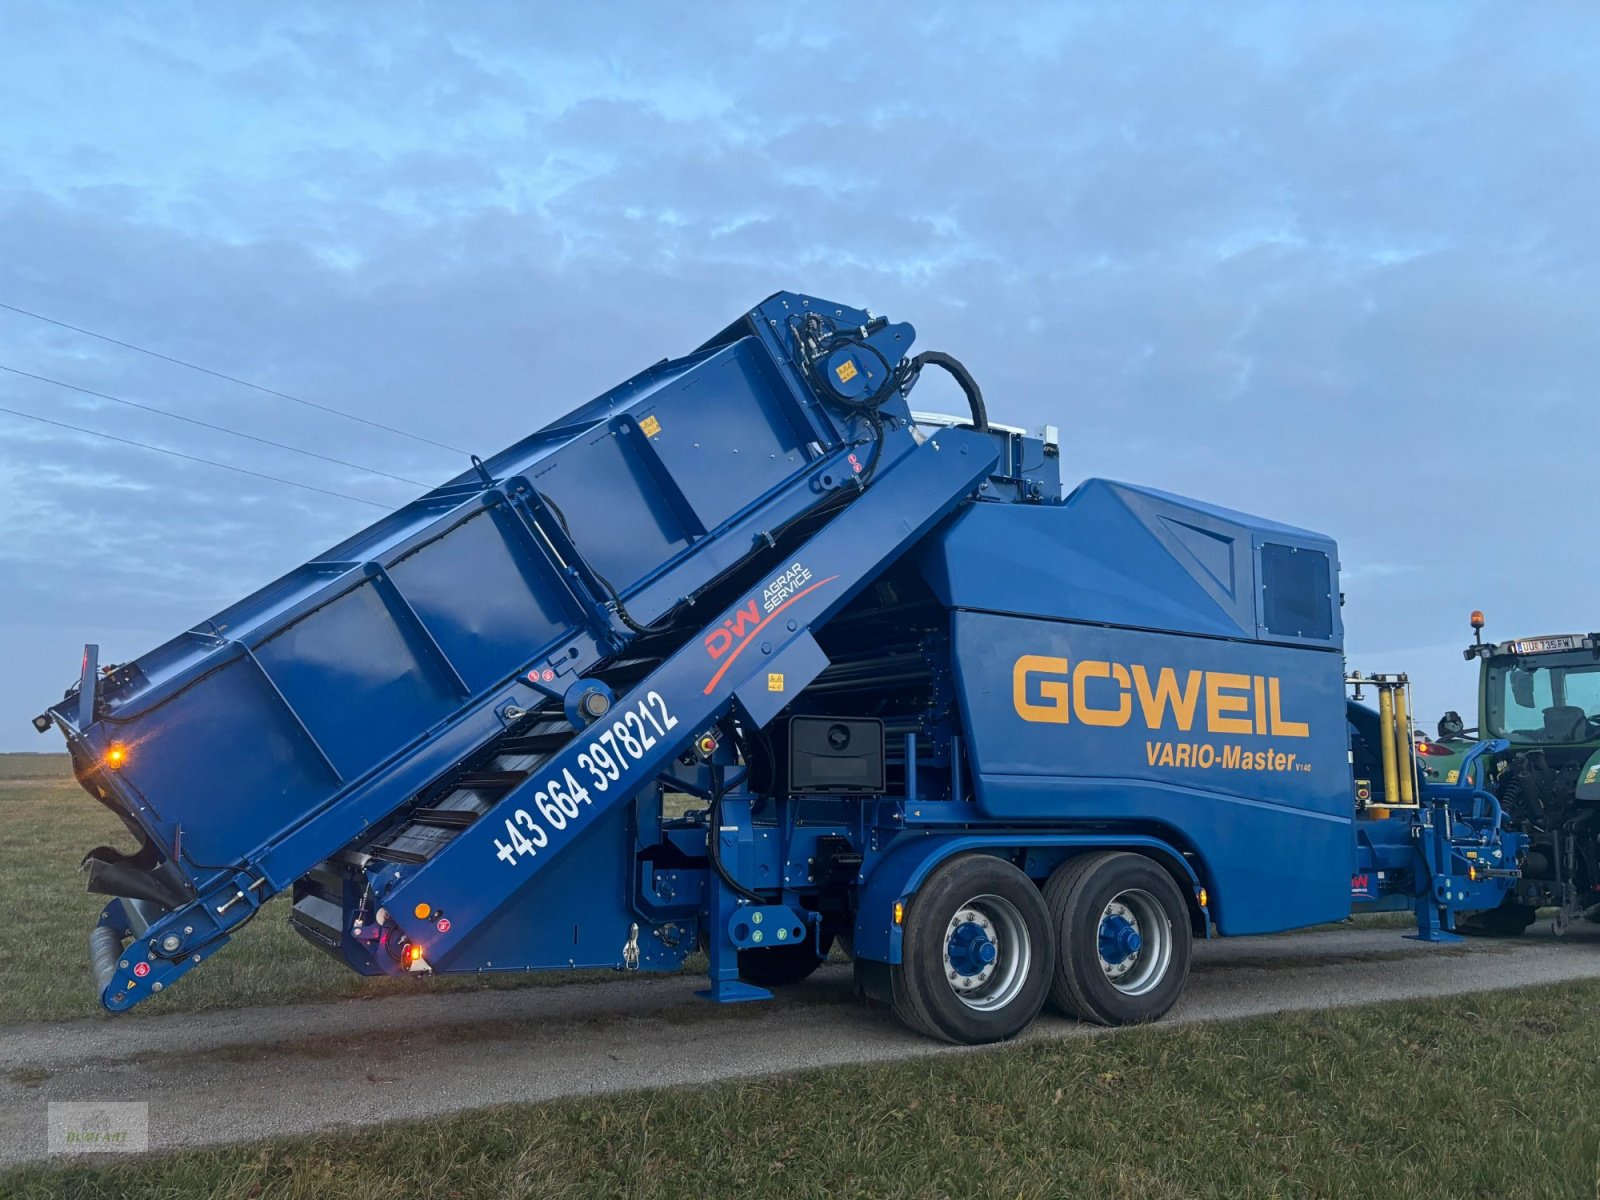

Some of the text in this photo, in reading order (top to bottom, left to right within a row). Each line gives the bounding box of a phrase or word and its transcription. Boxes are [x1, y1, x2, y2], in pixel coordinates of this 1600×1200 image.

[763, 562, 803, 601] AGRAR
[763, 568, 812, 613] SERVICE
[1146, 741, 1296, 771] VARIO-Master
[493, 690, 679, 866] +43 664 3978212
